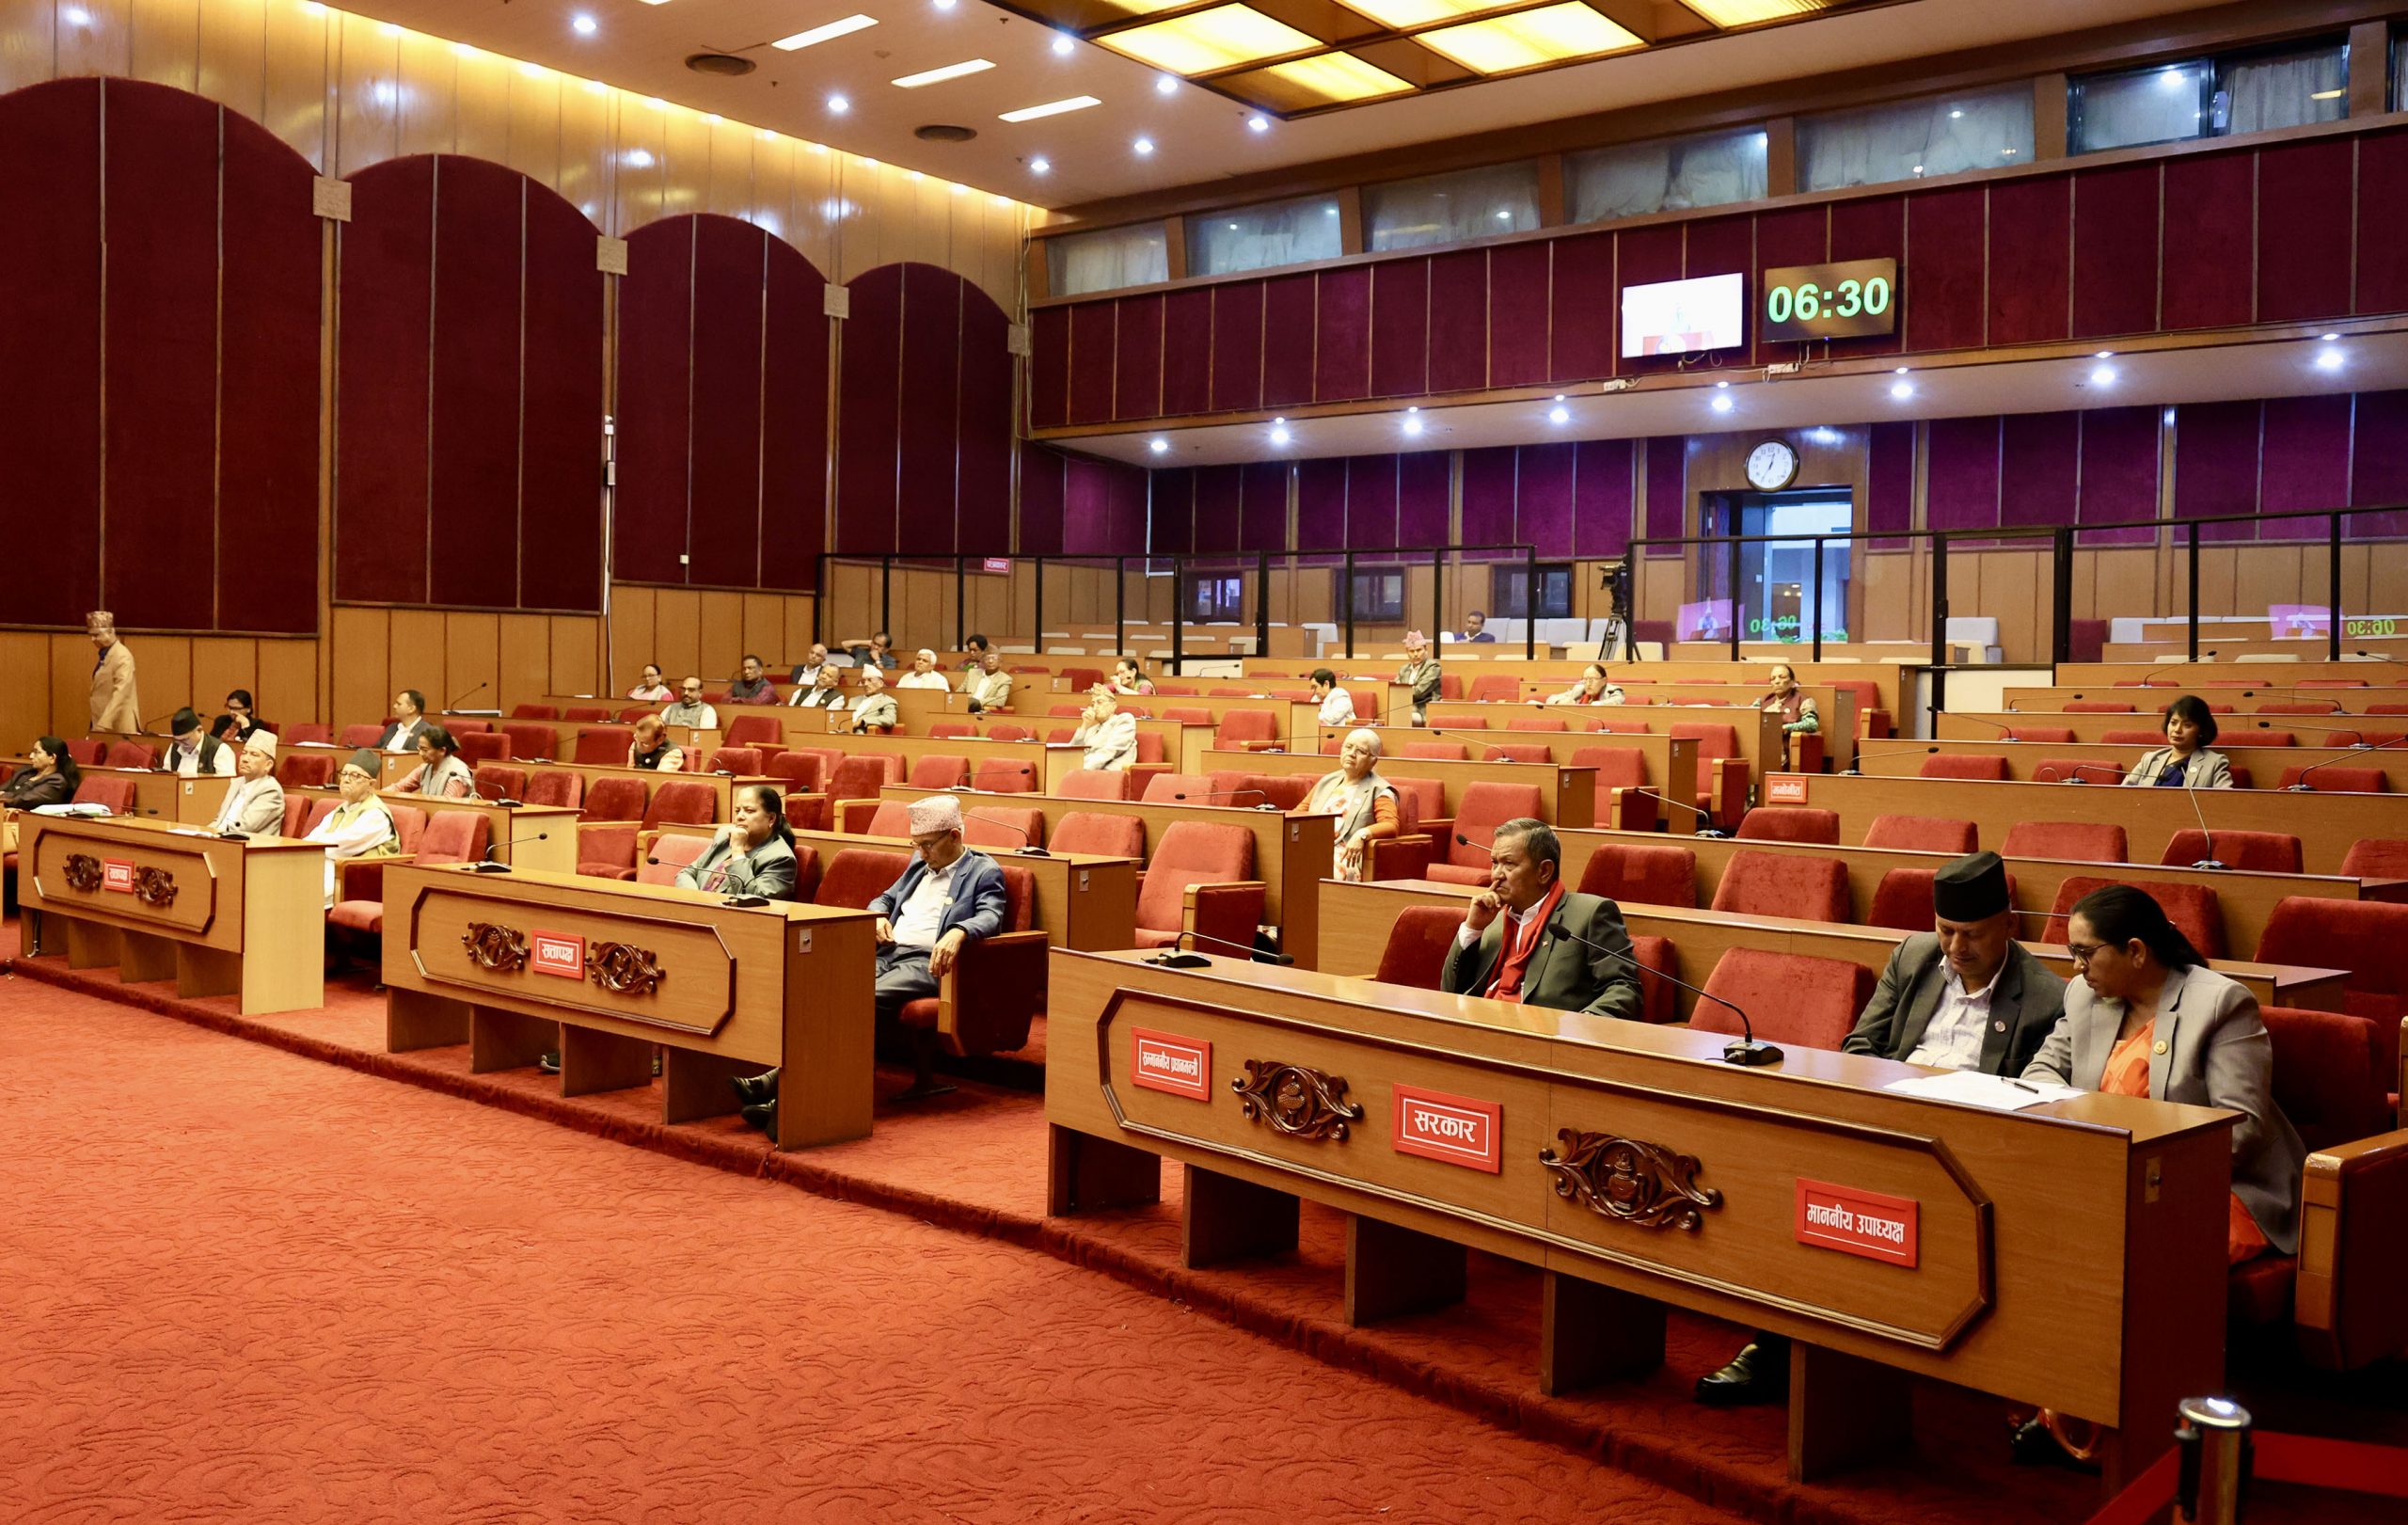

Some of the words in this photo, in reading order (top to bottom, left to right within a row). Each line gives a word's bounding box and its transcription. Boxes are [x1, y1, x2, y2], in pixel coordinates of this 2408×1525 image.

[1767, 277, 1890, 323] 06:30
[1414, 1109, 1478, 1143] सरकार
[1807, 1203, 1854, 1231] माननीय
